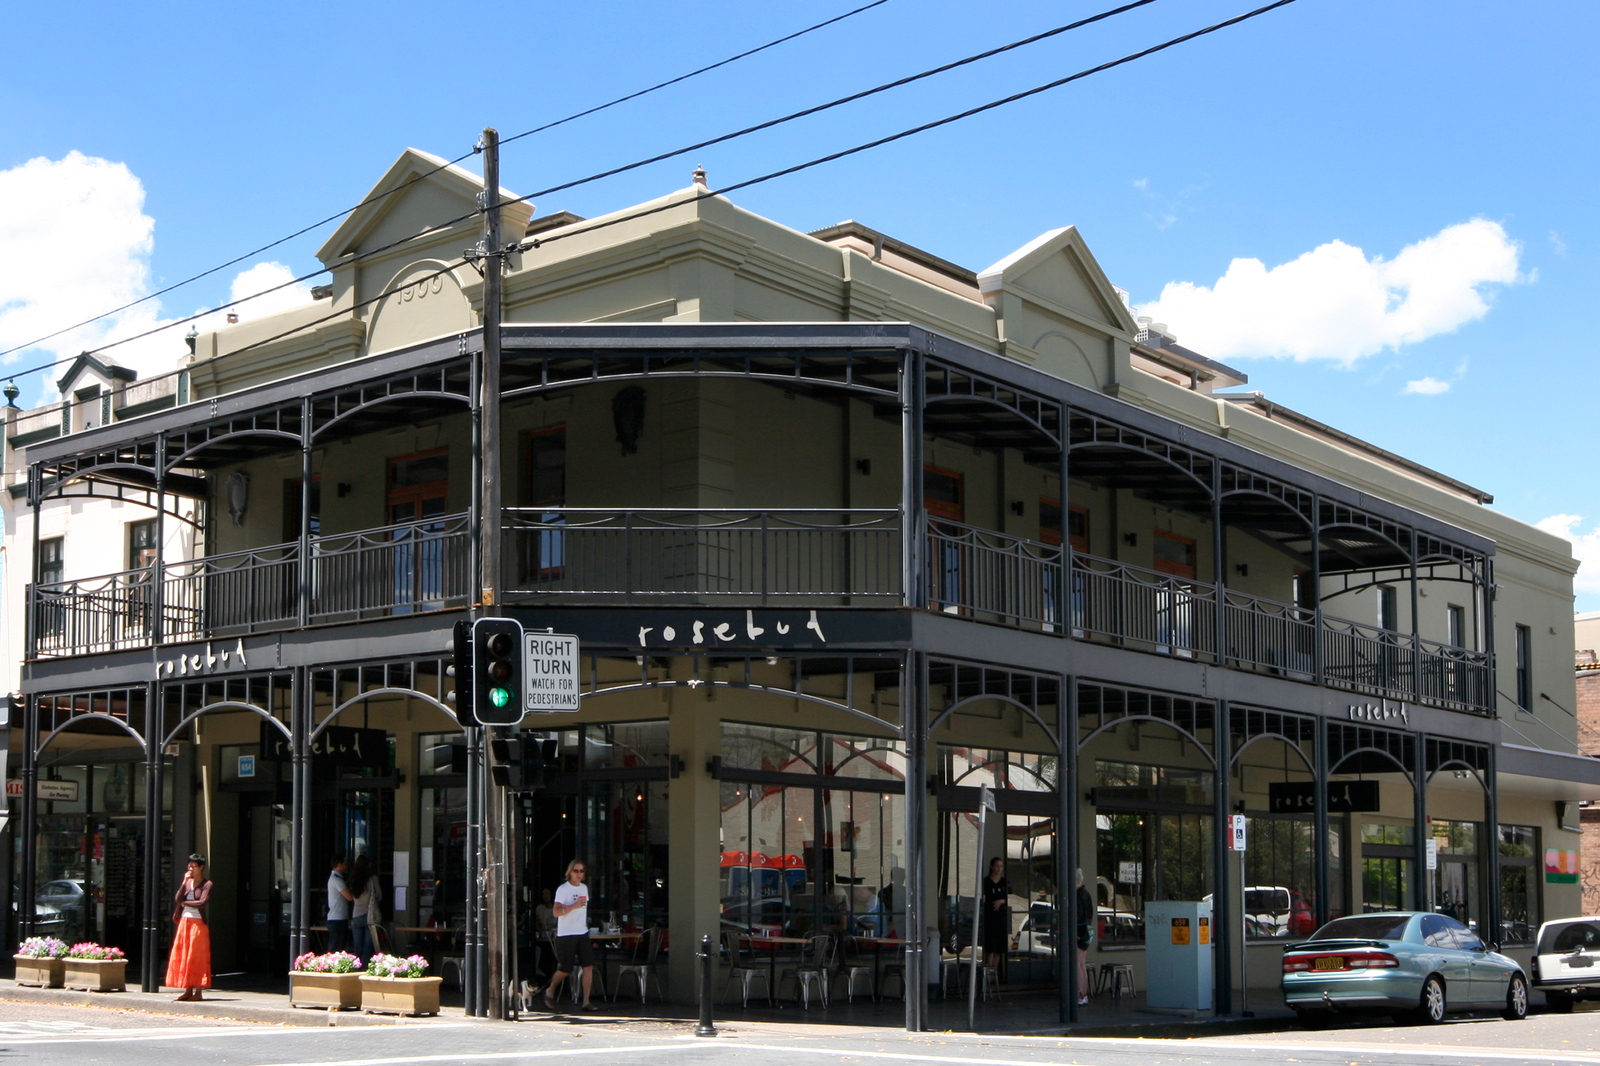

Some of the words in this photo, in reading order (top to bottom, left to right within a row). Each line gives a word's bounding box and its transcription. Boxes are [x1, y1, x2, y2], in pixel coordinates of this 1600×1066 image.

[395, 274, 444, 305] 1900
[638, 609, 826, 647] rosebud
[155, 638, 247, 679] rosebud
[530, 640, 572, 656] RIGHT
[533, 659, 571, 674] TURN
[532, 678, 555, 690] WATCH
[559, 679, 573, 690] FOR
[528, 693, 577, 705] PEDESTRIANS
[1350, 698, 1408, 725] rosebud
[275, 731, 362, 759] roebud
[1276, 784, 1353, 809] roseud
